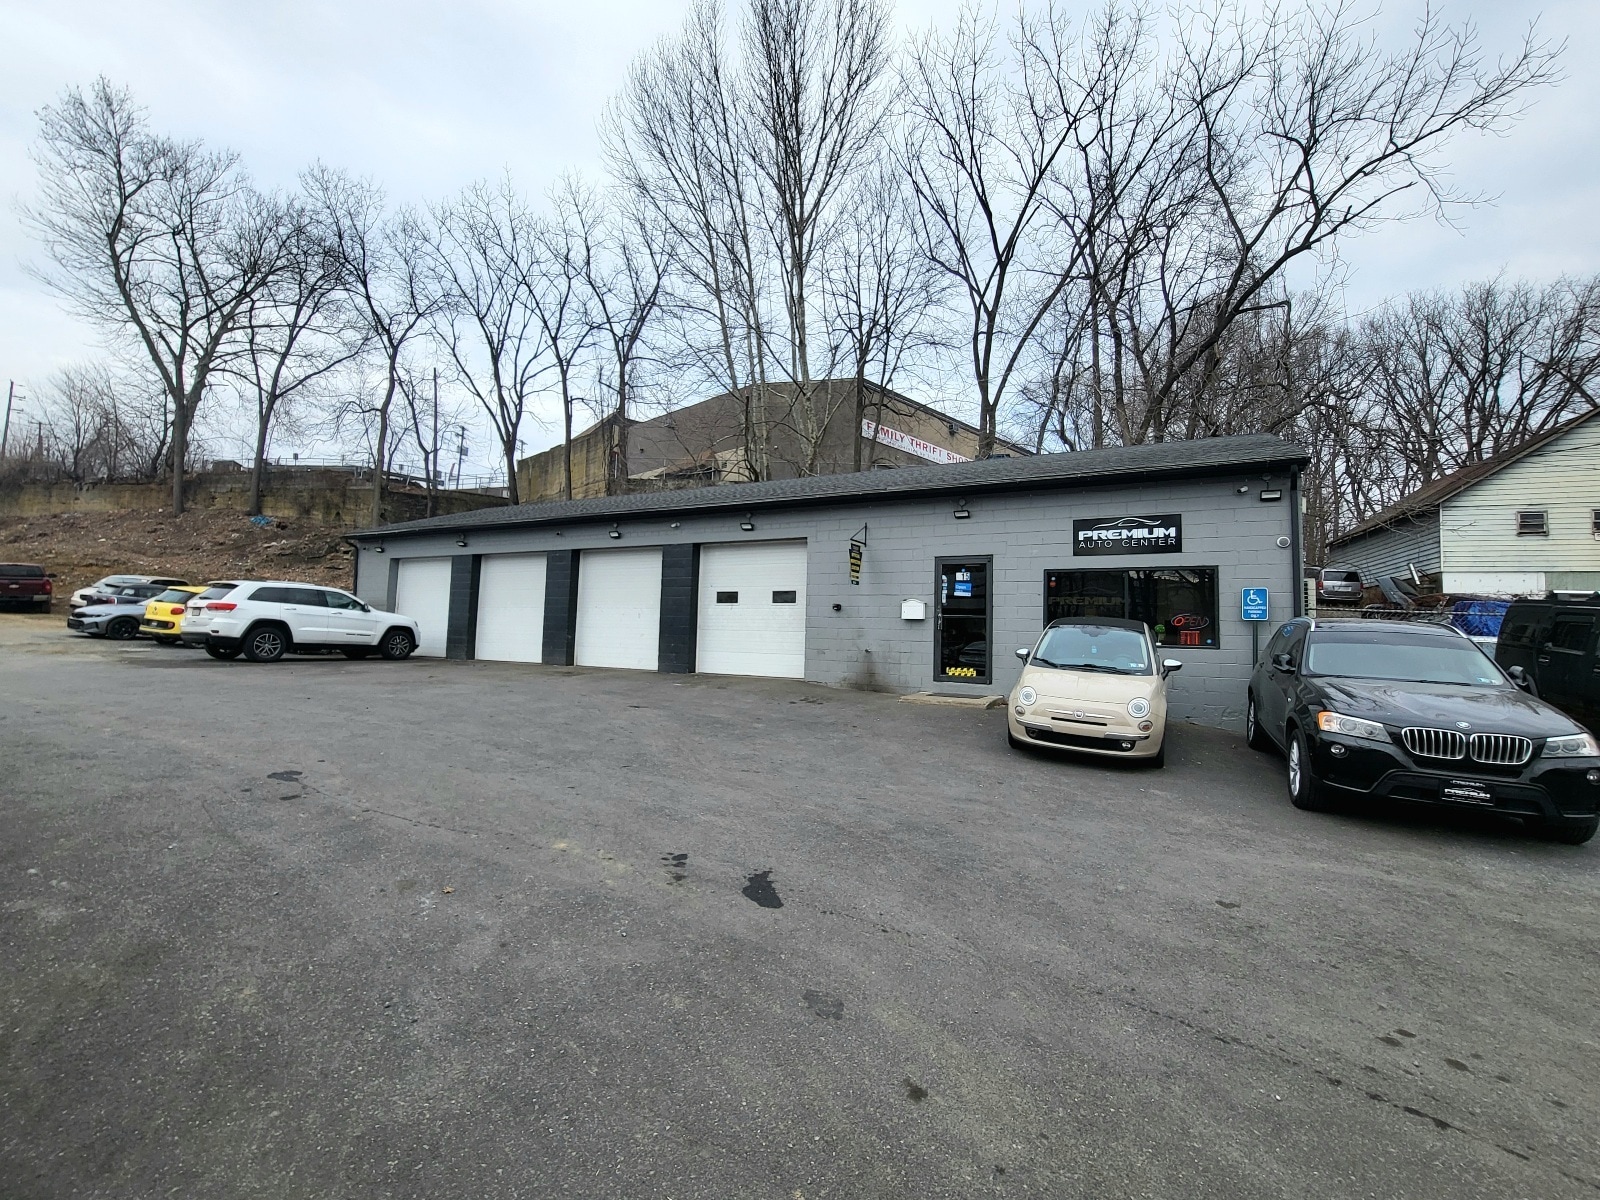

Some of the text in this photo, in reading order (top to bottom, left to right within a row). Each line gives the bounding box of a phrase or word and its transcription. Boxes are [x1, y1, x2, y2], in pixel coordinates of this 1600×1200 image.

[866, 421, 906, 443] FMILY
[909, 437, 943, 458] THRIFT
[1078, 527, 1176, 541] PREMIUM
[1078, 537, 1176, 549] AUTO CENTER
[1174, 616, 1206, 626] OPEN
